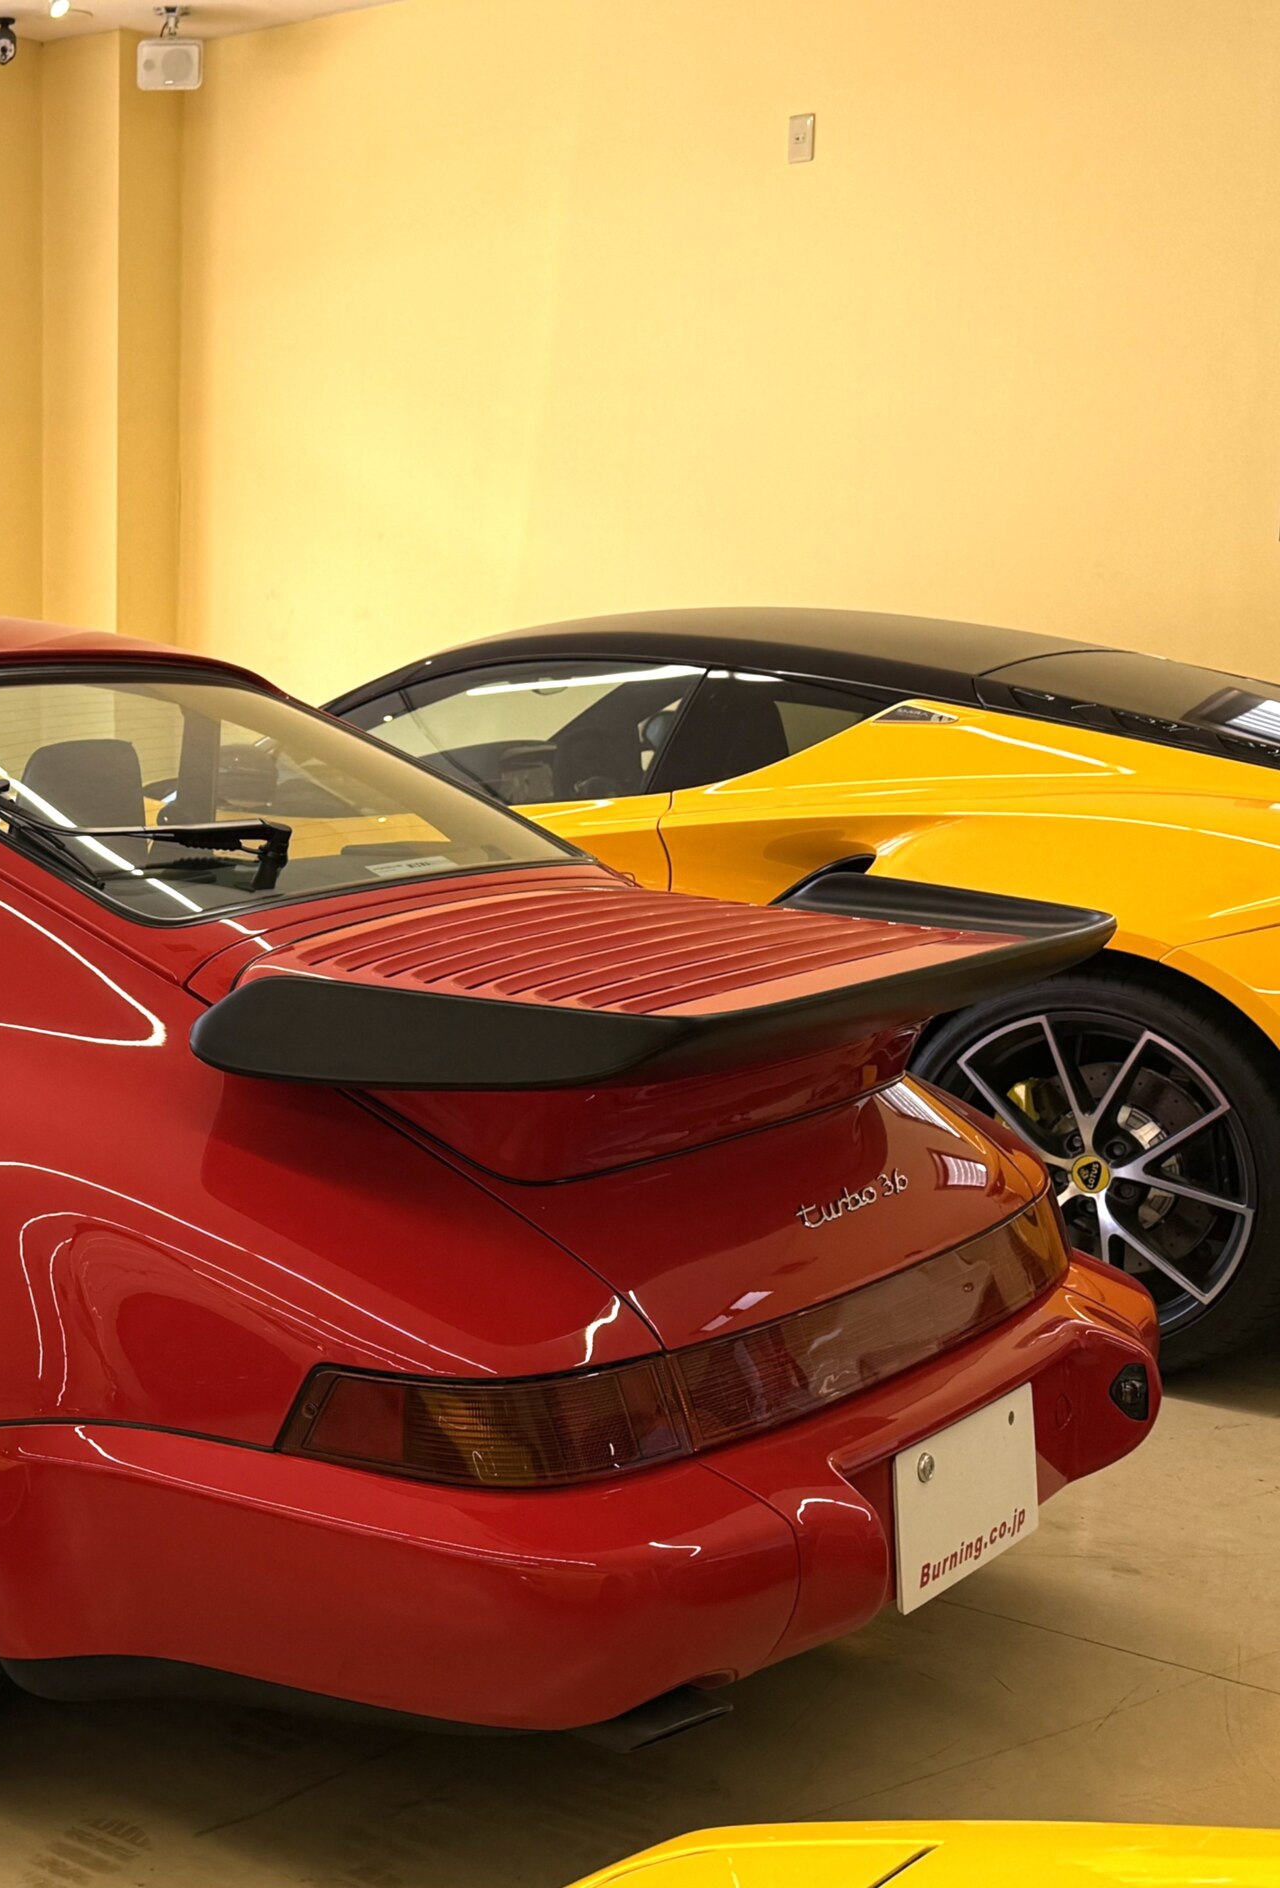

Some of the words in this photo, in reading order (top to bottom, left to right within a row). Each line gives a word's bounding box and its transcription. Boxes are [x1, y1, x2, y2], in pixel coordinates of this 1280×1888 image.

[1087, 1163, 1099, 1188] LOTUS
[796, 1186, 877, 1228] turbo
[920, 1508, 1025, 1588] Burning.co.jp
